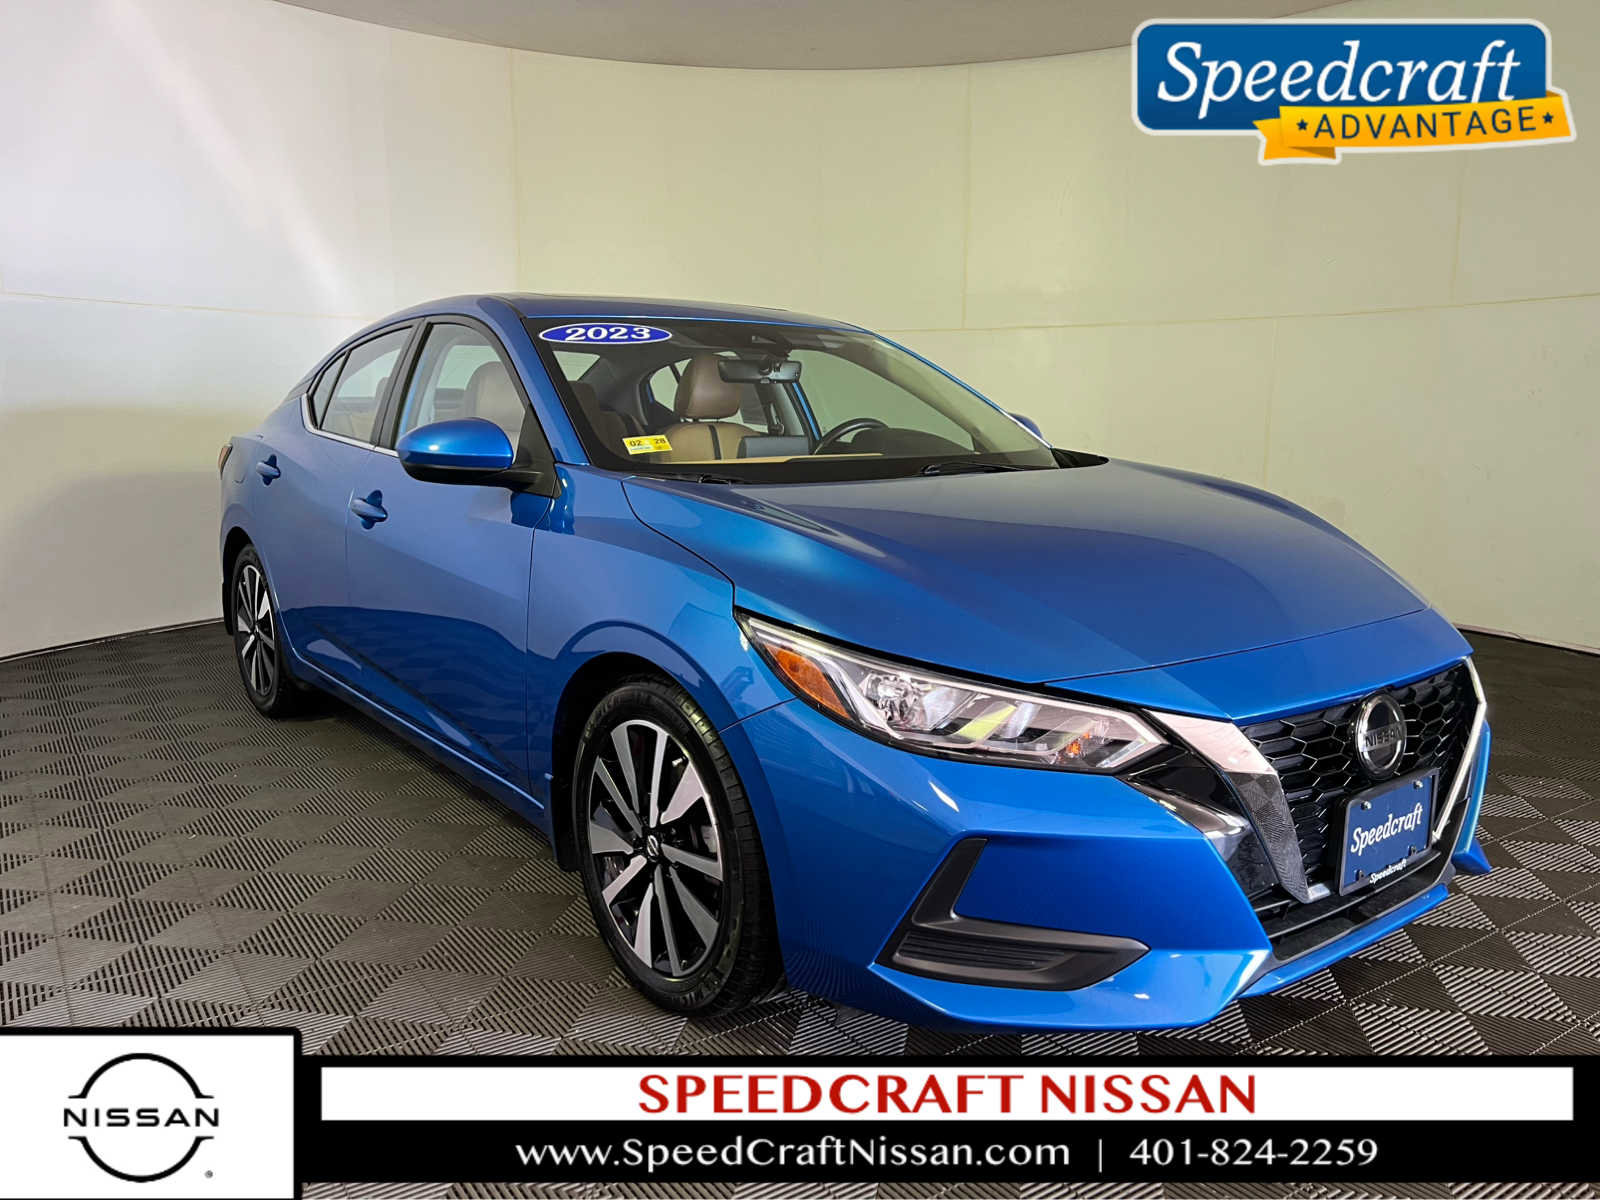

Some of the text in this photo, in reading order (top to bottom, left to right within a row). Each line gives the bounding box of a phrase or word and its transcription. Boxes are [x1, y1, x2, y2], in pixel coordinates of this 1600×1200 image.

[565, 327, 651, 341] 2023
[1350, 802, 1423, 856] Speedcraft
[1369, 858, 1407, 884] Speedcraft
